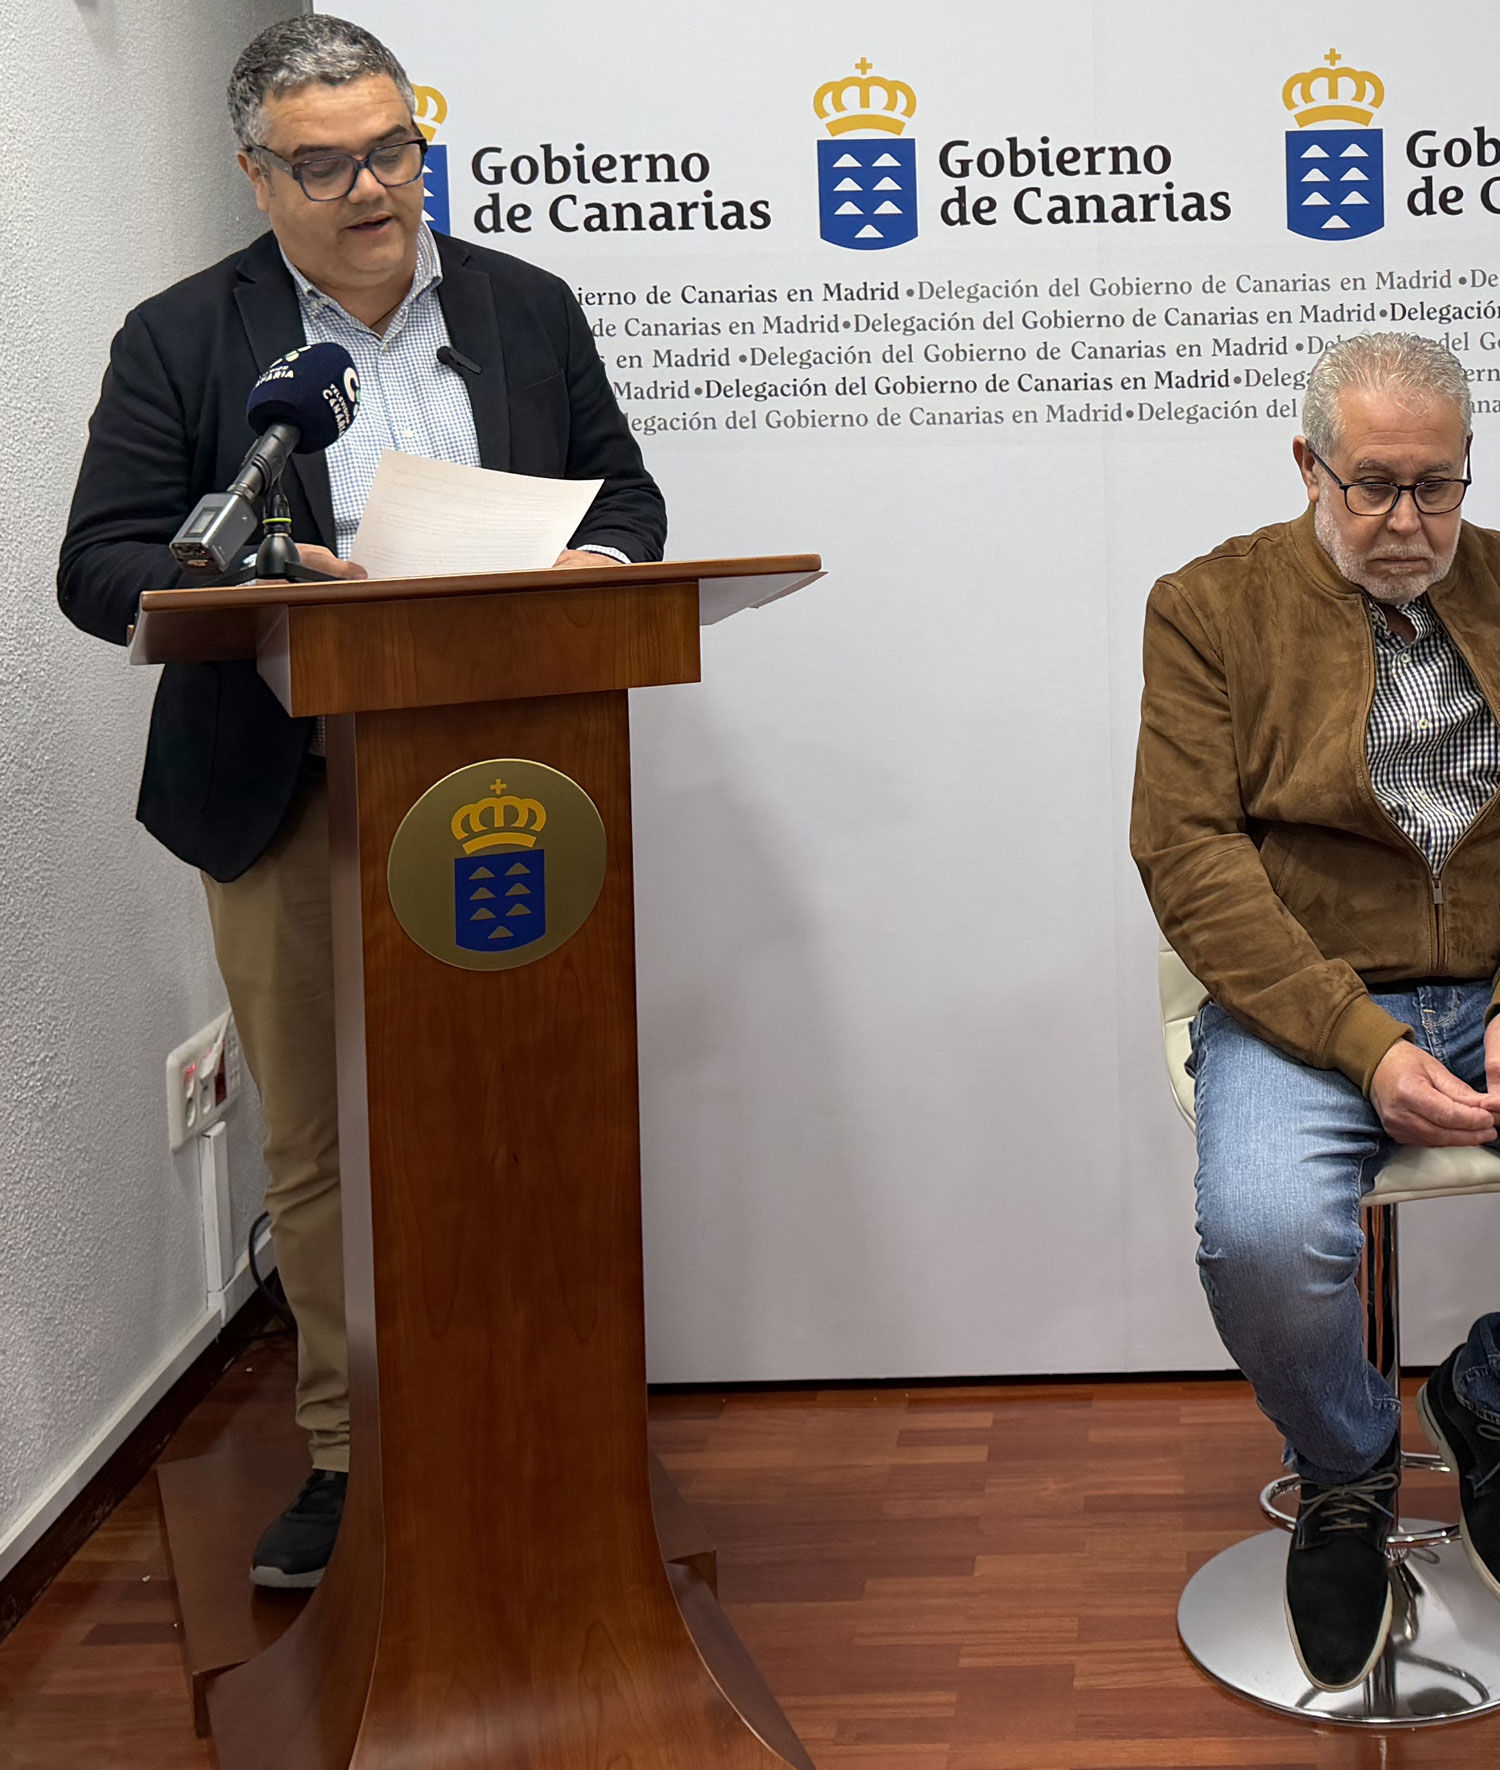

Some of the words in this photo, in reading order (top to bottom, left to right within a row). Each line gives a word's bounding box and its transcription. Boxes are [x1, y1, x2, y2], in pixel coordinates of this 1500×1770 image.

[471, 143, 710, 186] Gobierno
[938, 135, 1172, 179] Gobierno
[473, 192, 532, 234] de
[548, 189, 772, 233] Canarias
[940, 185, 997, 227] de
[1013, 181, 1232, 225] Canarias
[1407, 175, 1464, 217] de
[576, 286, 637, 308] ierno
[645, 284, 672, 306] de
[680, 283, 778, 305] Canarias
[786, 288, 815, 303] en
[821, 280, 901, 303] Madrid
[917, 278, 1040, 304] Delegación
[1048, 277, 1081, 298] del
[1089, 276, 1193, 298] Gobierno
[1201, 274, 1227, 295] de
[1235, 272, 1332, 294] Canarias
[1339, 276, 1367, 292] en
[1374, 268, 1453, 291] Madrid
[623, 316, 722, 338] Canarias
[728, 320, 757, 336] en
[761, 313, 841, 335] Madrid
[853, 311, 976, 337] Delegación
[982, 309, 1015, 331] del
[1021, 308, 1126, 331] Gobierno
[1131, 306, 1158, 328] de
[1163, 305, 1260, 328] Canarias
[1265, 309, 1294, 325] en
[1298, 301, 1377, 324] Madrid
[615, 354, 644, 370] en
[647, 346, 732, 369] Madrid
[749, 344, 873, 371] Delegación
[881, 343, 915, 365] del
[923, 342, 1027, 364] Gobierno
[1035, 340, 1062, 361] de
[1070, 339, 1167, 361] Canarias
[1175, 343, 1203, 359] en
[1210, 335, 1289, 358] Madrid
[612, 378, 692, 401] Madrid
[704, 377, 828, 403] Delegación
[834, 375, 868, 397] del
[874, 374, 978, 396] Gobierno
[984, 372, 1011, 394] de
[1016, 371, 1114, 393] Canarias
[1119, 375, 1148, 391] en
[1152, 367, 1231, 390] Madrid
[1243, 367, 1312, 392] Deleg
[724, 409, 758, 430] del
[764, 408, 869, 429] Gobierno
[876, 406, 902, 427] de
[908, 405, 1005, 427] Canarias
[1011, 409, 1039, 425] en
[1045, 401, 1124, 424] Madrid
[1137, 399, 1259, 425] Delegación
[1265, 397, 1298, 419] del
